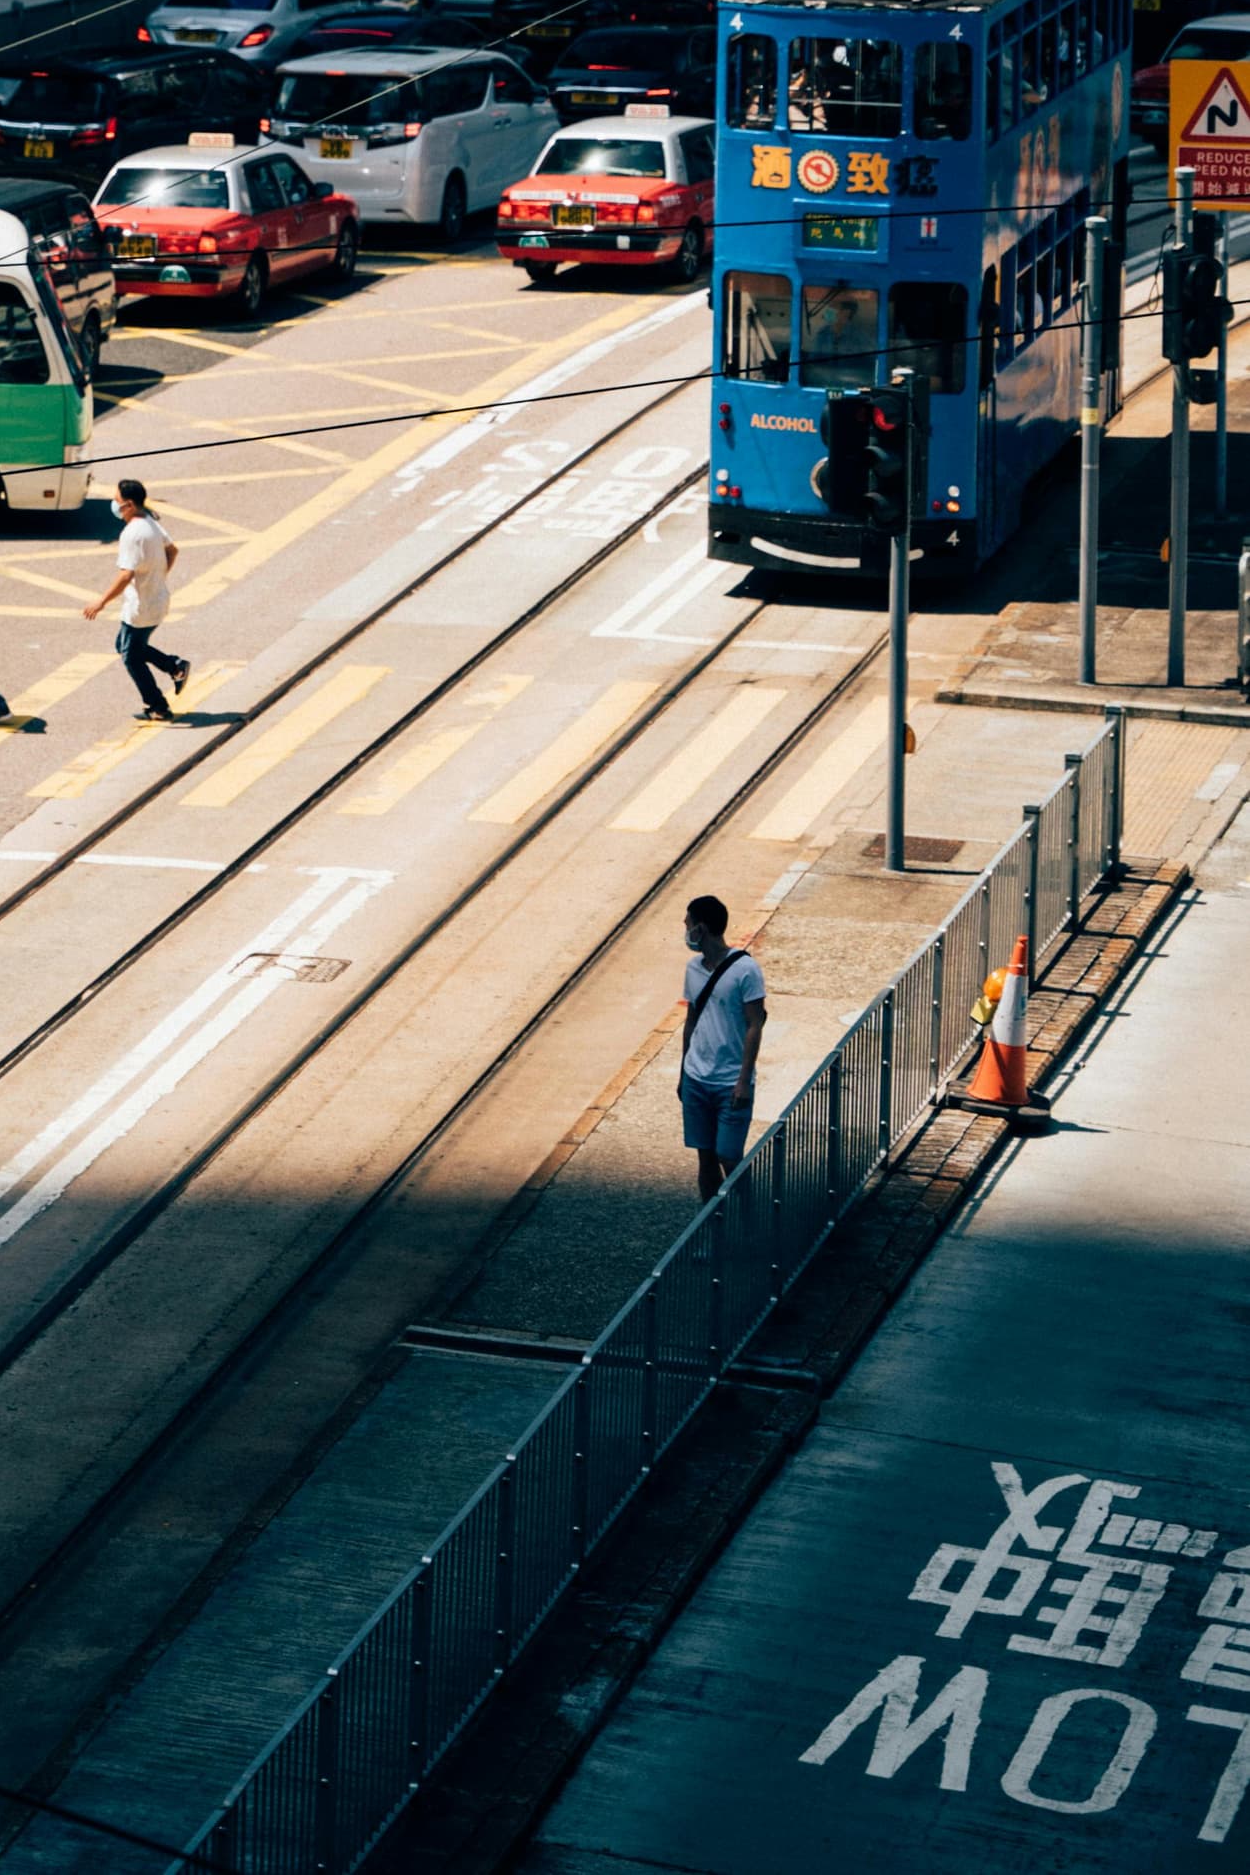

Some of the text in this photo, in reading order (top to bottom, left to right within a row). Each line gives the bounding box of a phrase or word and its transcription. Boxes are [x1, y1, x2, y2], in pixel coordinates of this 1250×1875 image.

[730, 12, 744, 31] 4
[948, 23, 963, 41] 4
[751, 144, 793, 189] 酒
[1197, 152, 1250, 164] REDUCE
[1190, 165, 1228, 176] PEED
[751, 412, 817, 434] ALCOHOL
[946, 529, 960, 547] 4
